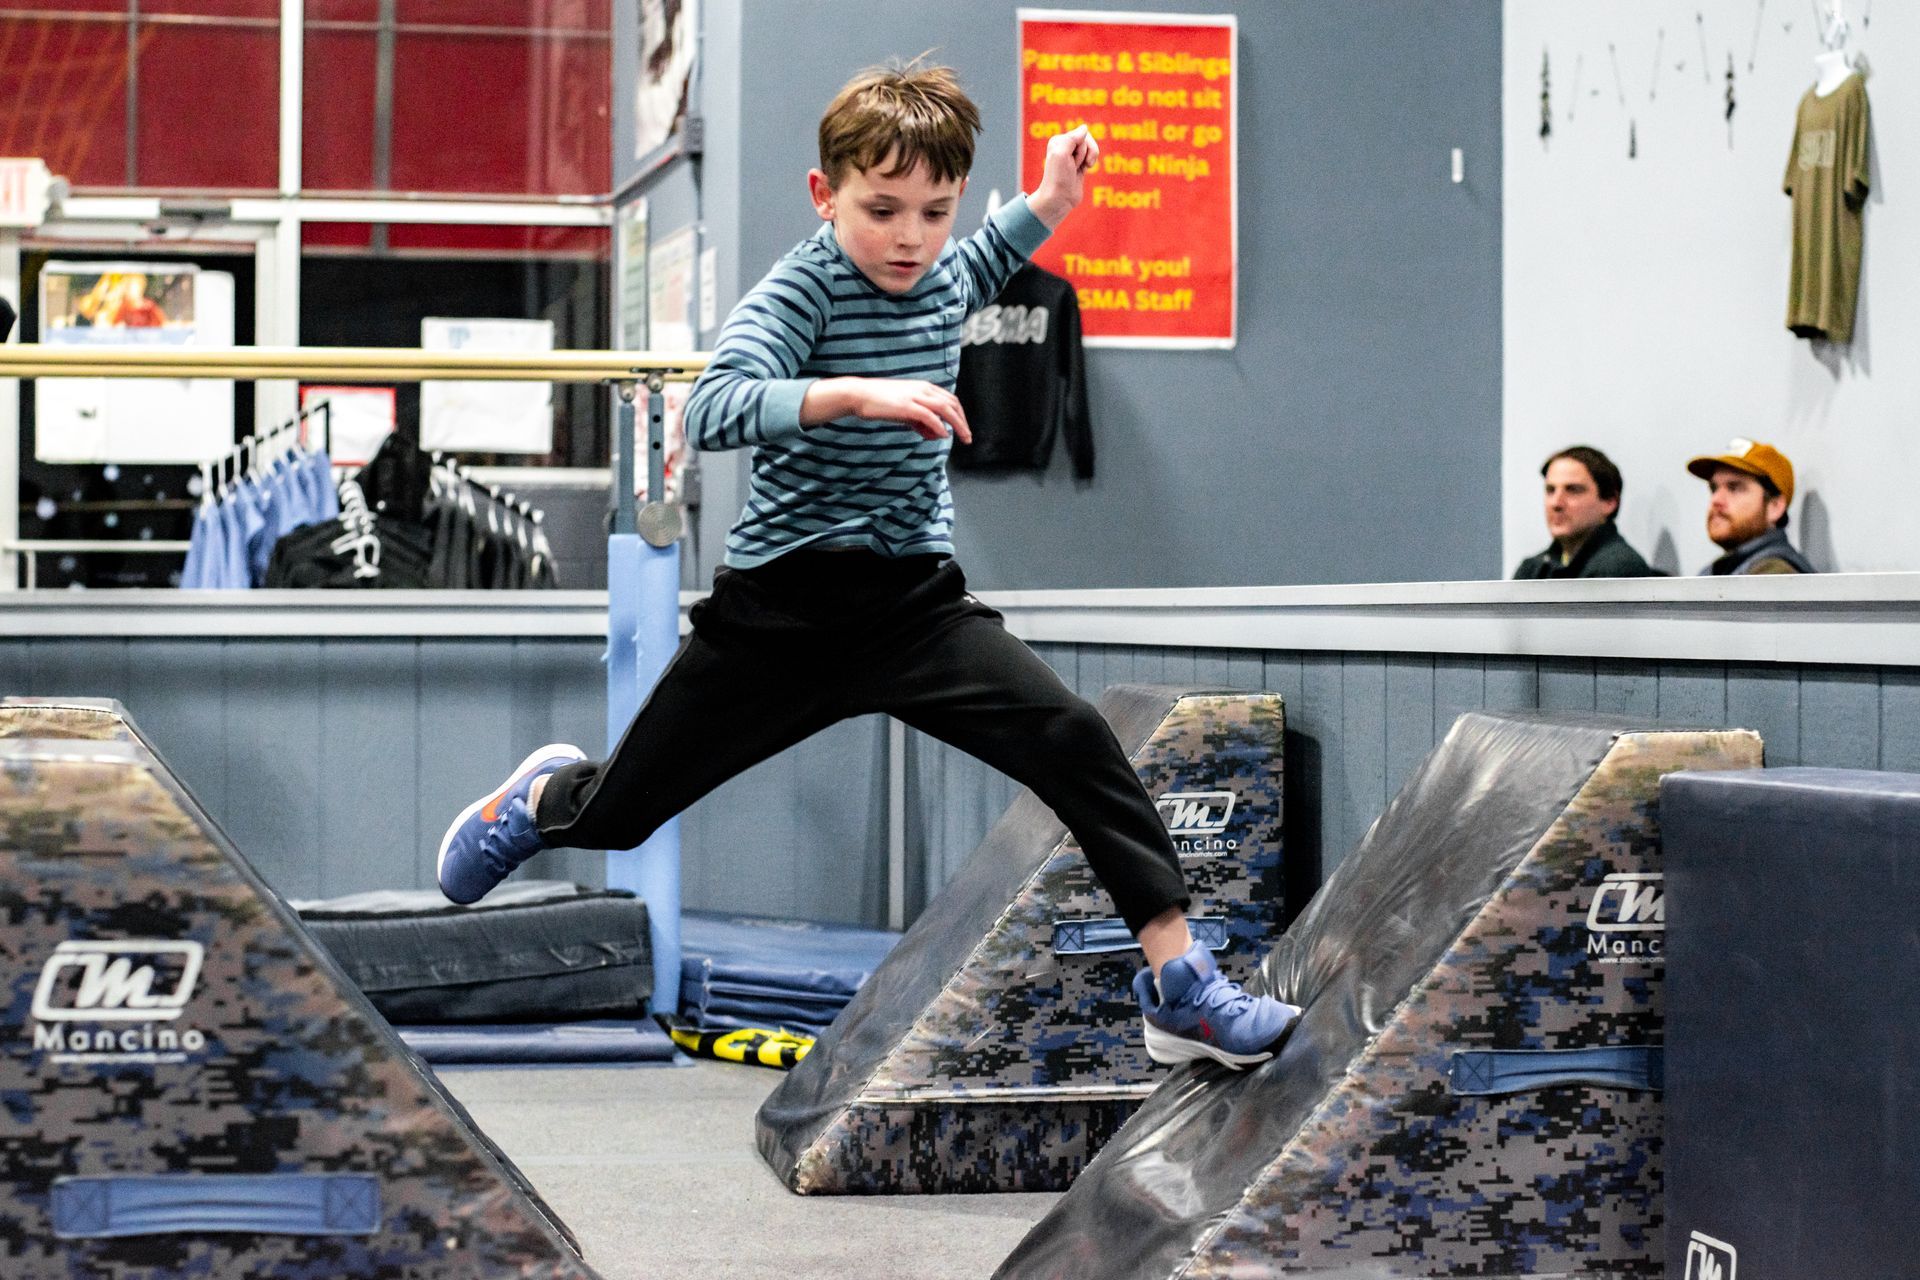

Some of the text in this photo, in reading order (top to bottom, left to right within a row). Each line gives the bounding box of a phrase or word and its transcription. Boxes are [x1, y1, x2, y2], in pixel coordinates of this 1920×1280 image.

[1023, 49, 1231, 80] Parents & Siblings
[1030, 83, 1222, 109] Please do not sit
[1030, 118, 1223, 148] on te wall or go
[1103, 153, 1144, 175] the
[1147, 153, 1210, 181] Ninja
[0, 166, 31, 213] IT
[1092, 185, 1161, 209] Floor!
[1062, 254, 1191, 282] Thank you!
[1076, 288, 1194, 311] SMA Staff
[1172, 836, 1237, 851] ncino
[1178, 850, 1228, 858] ancinomats.com
[1586, 933, 1661, 954] Manc
[33, 1022, 205, 1051] Mancino
